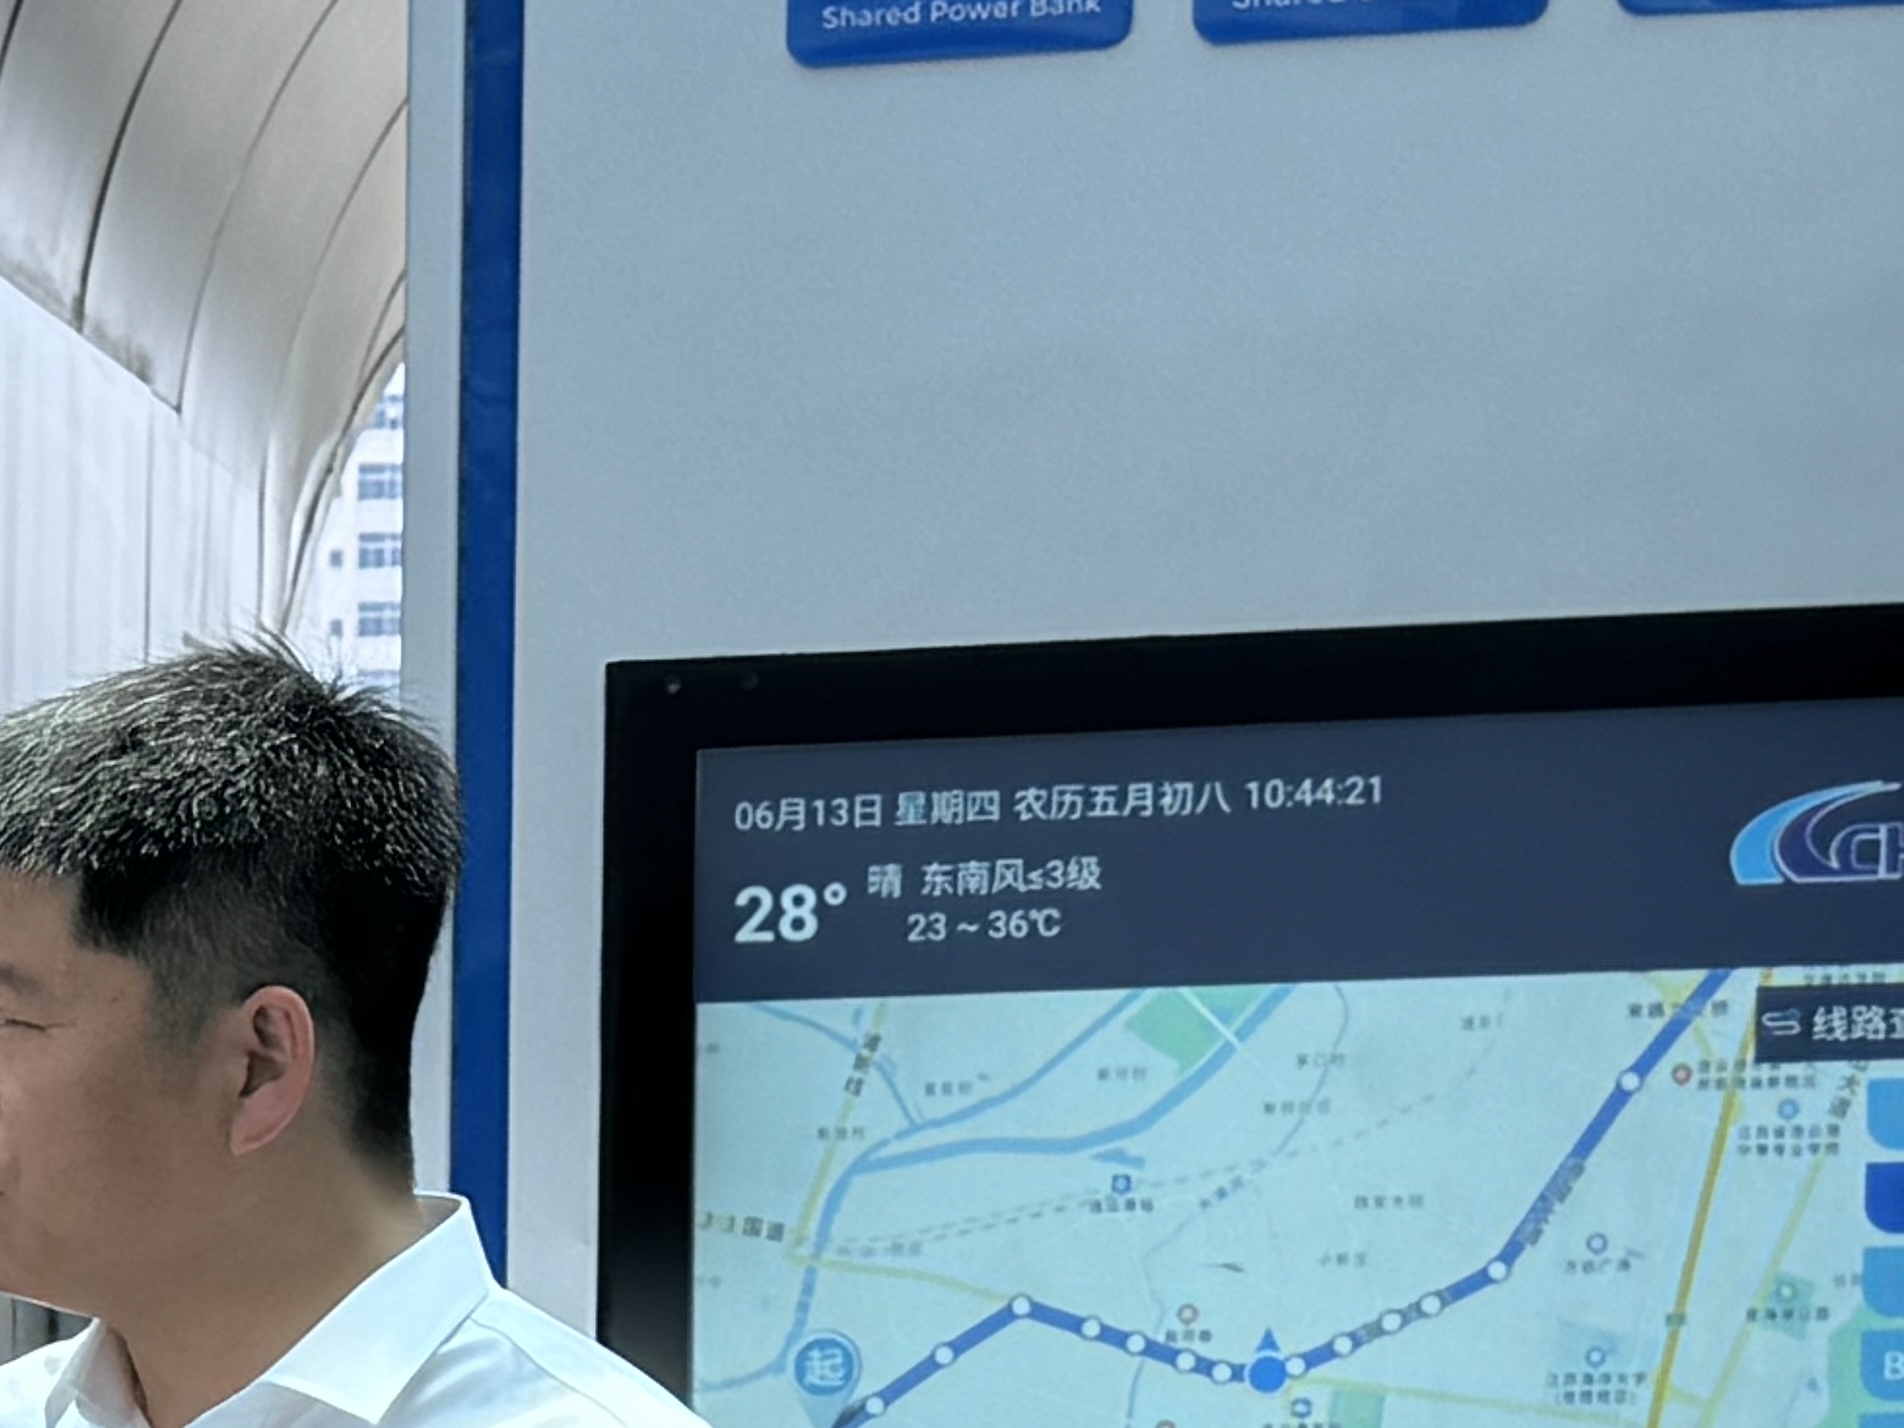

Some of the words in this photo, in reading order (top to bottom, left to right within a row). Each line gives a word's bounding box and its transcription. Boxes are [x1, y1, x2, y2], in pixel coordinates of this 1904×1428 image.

[822, 4, 921, 30] Shared
[930, 1, 1019, 23] Power
[735, 796, 883, 831] 06月13日
[894, 789, 1001, 827] 星期四
[1013, 780, 1231, 822] 农历五月初八
[1246, 775, 1383, 810] 10:44:21
[867, 864, 902, 899] 晴
[907, 914, 947, 941] 23
